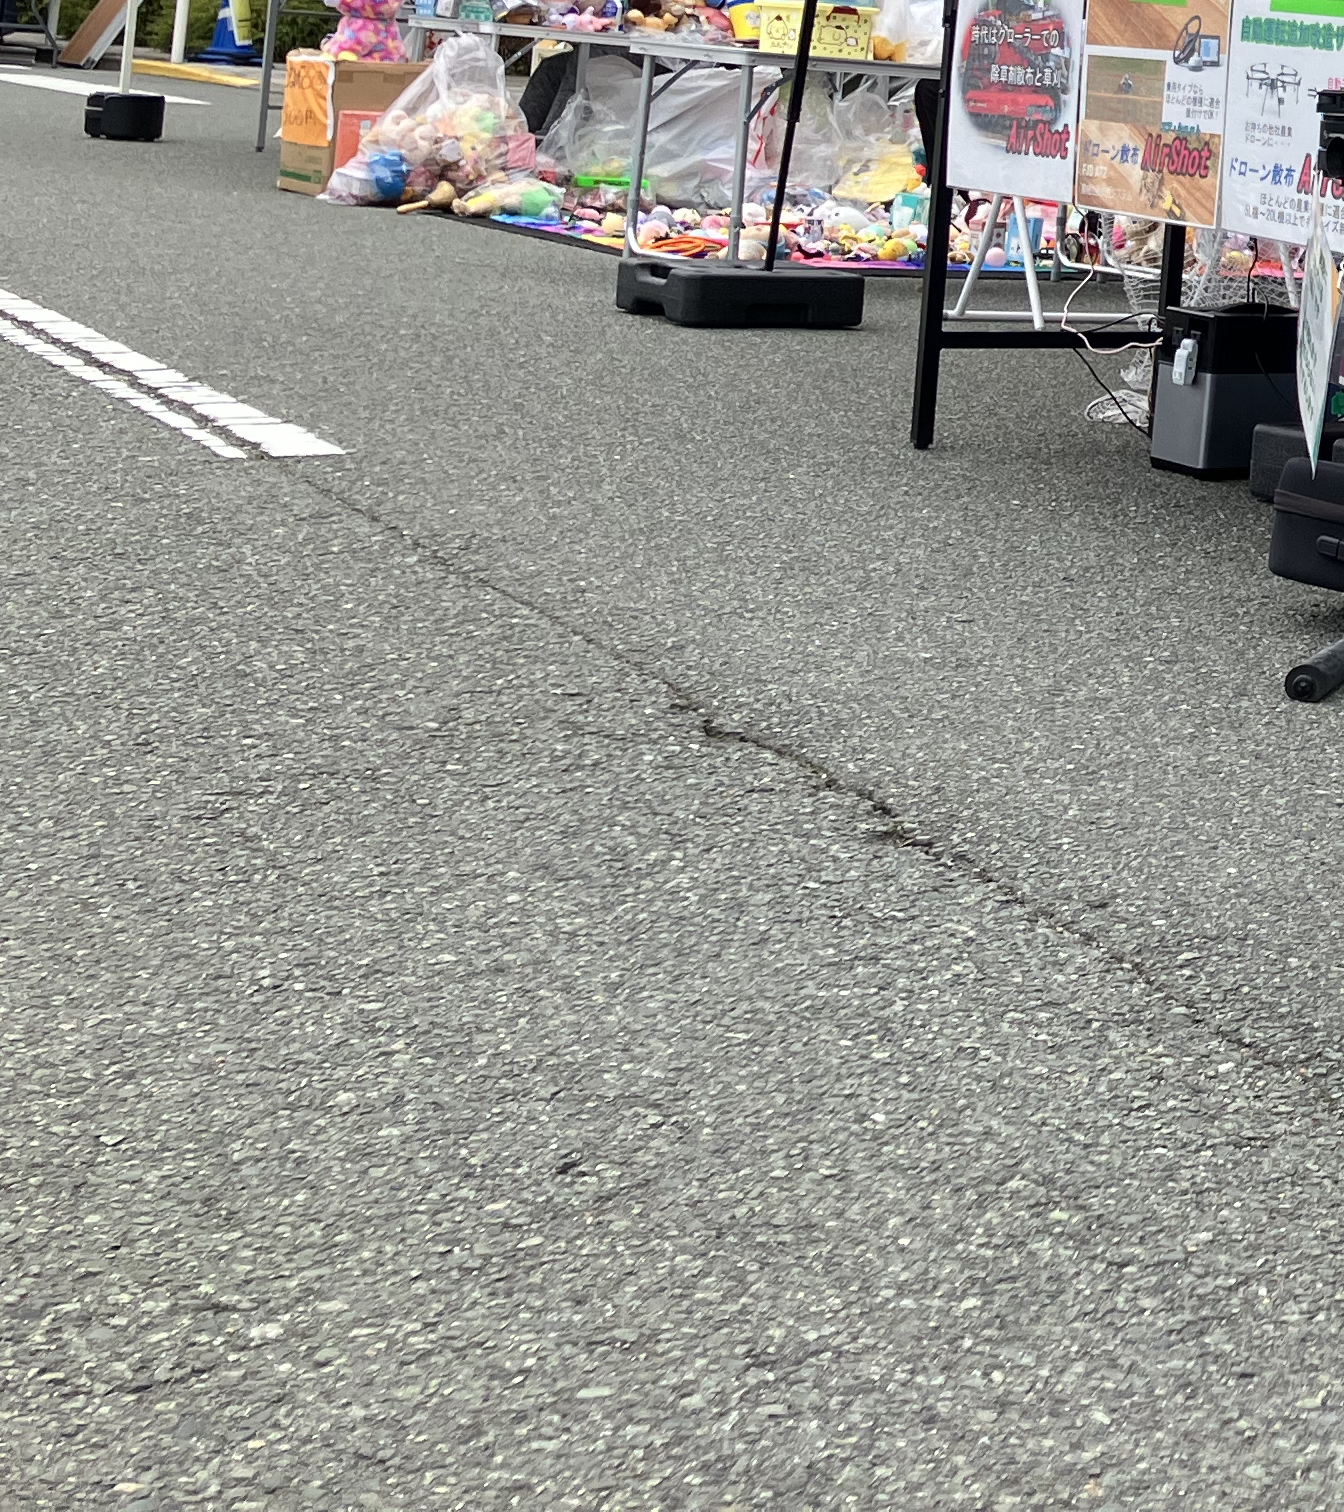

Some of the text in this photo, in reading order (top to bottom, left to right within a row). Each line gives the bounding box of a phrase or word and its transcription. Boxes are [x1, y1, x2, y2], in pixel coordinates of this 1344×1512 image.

[971, 25, 1059, 47] 時代はクローラーでの
[1006, 119, 1070, 160] AirShot
[1084, 133, 1212, 179] ドローン散布 AirShot
[1230, 156, 1296, 187] ドローン散布
